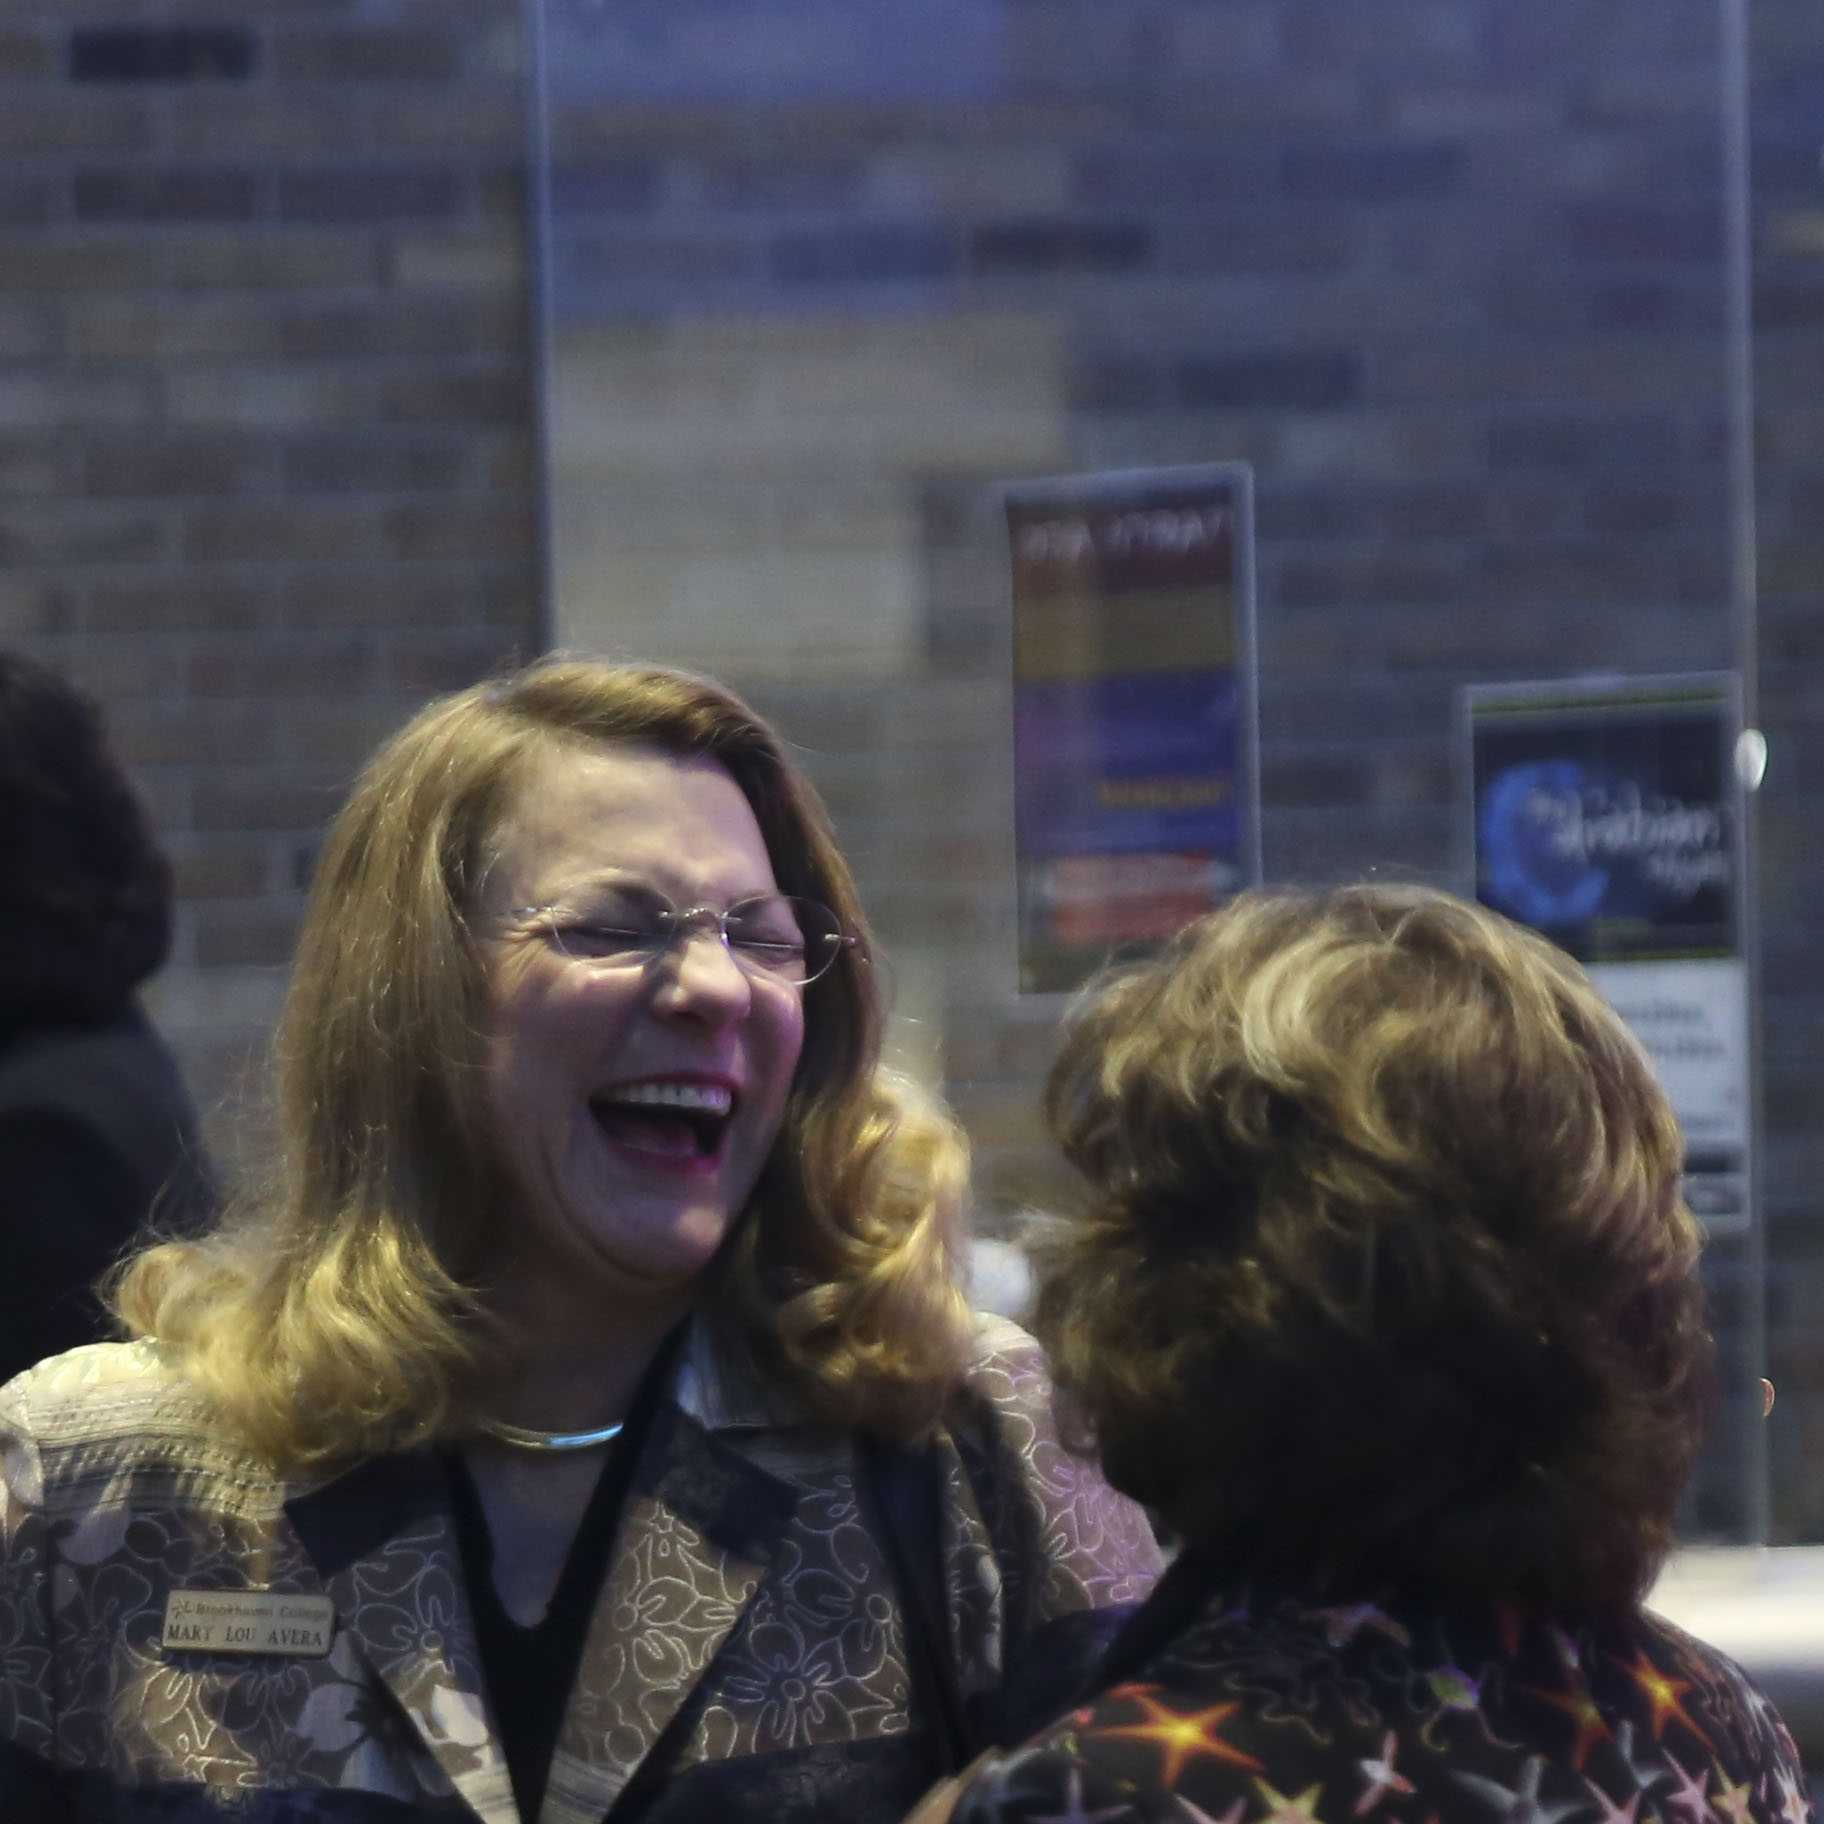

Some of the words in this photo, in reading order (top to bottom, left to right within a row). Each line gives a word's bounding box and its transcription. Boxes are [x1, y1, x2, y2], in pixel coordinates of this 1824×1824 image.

[168, 1624, 215, 1641] MARY
[226, 1625, 255, 1642] LOU
[267, 1627, 322, 1646] AVERA
